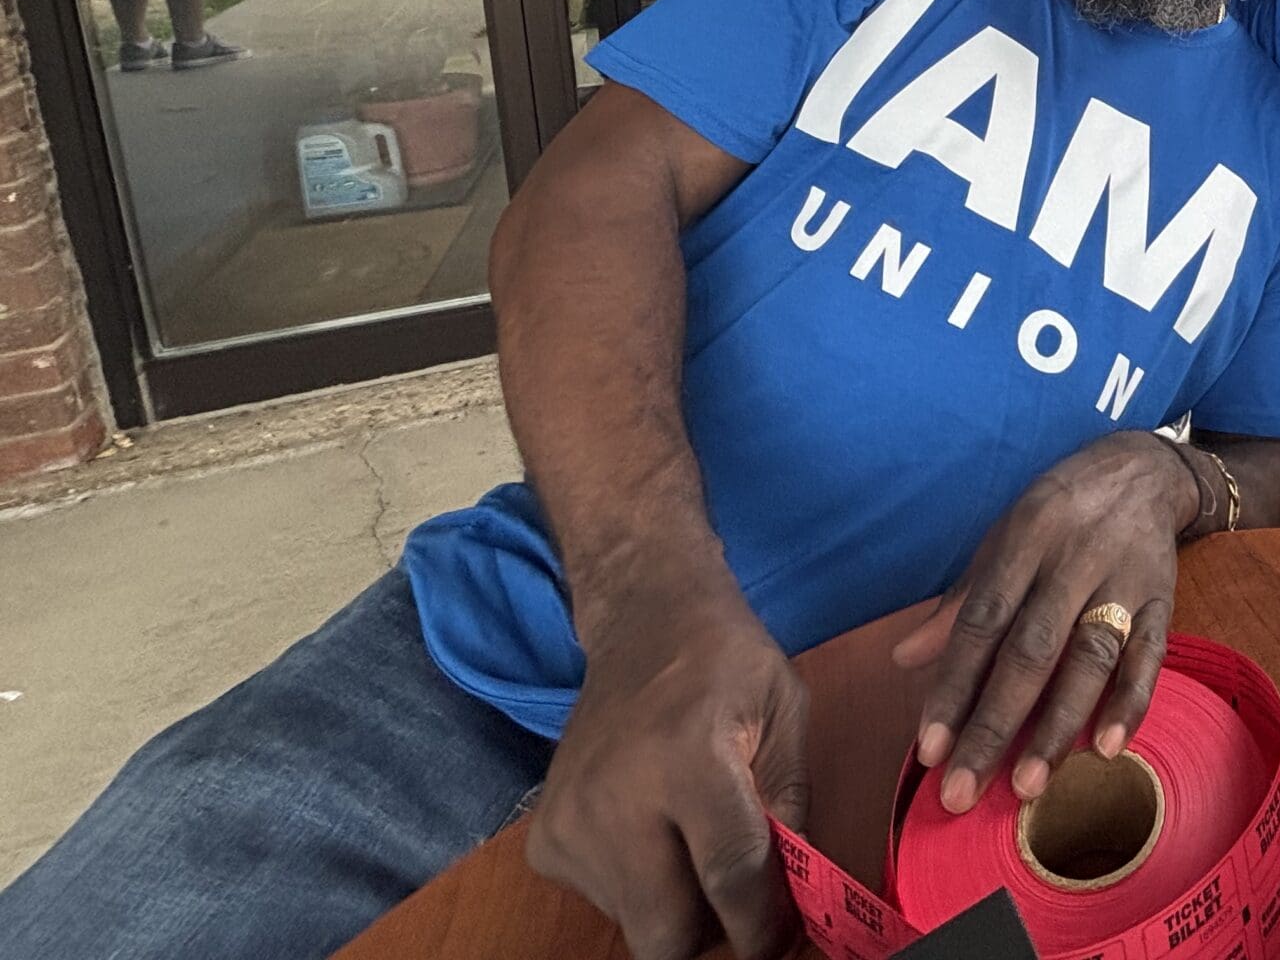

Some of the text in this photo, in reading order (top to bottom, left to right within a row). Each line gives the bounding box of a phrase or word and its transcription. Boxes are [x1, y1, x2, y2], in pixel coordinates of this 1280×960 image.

[790, 185, 1145, 422] UNION
[841, 880, 884, 920] TICKET
[844, 896, 885, 937] BILLET
[1163, 875, 1222, 932] TICKET
[1168, 892, 1223, 950] BILLET
